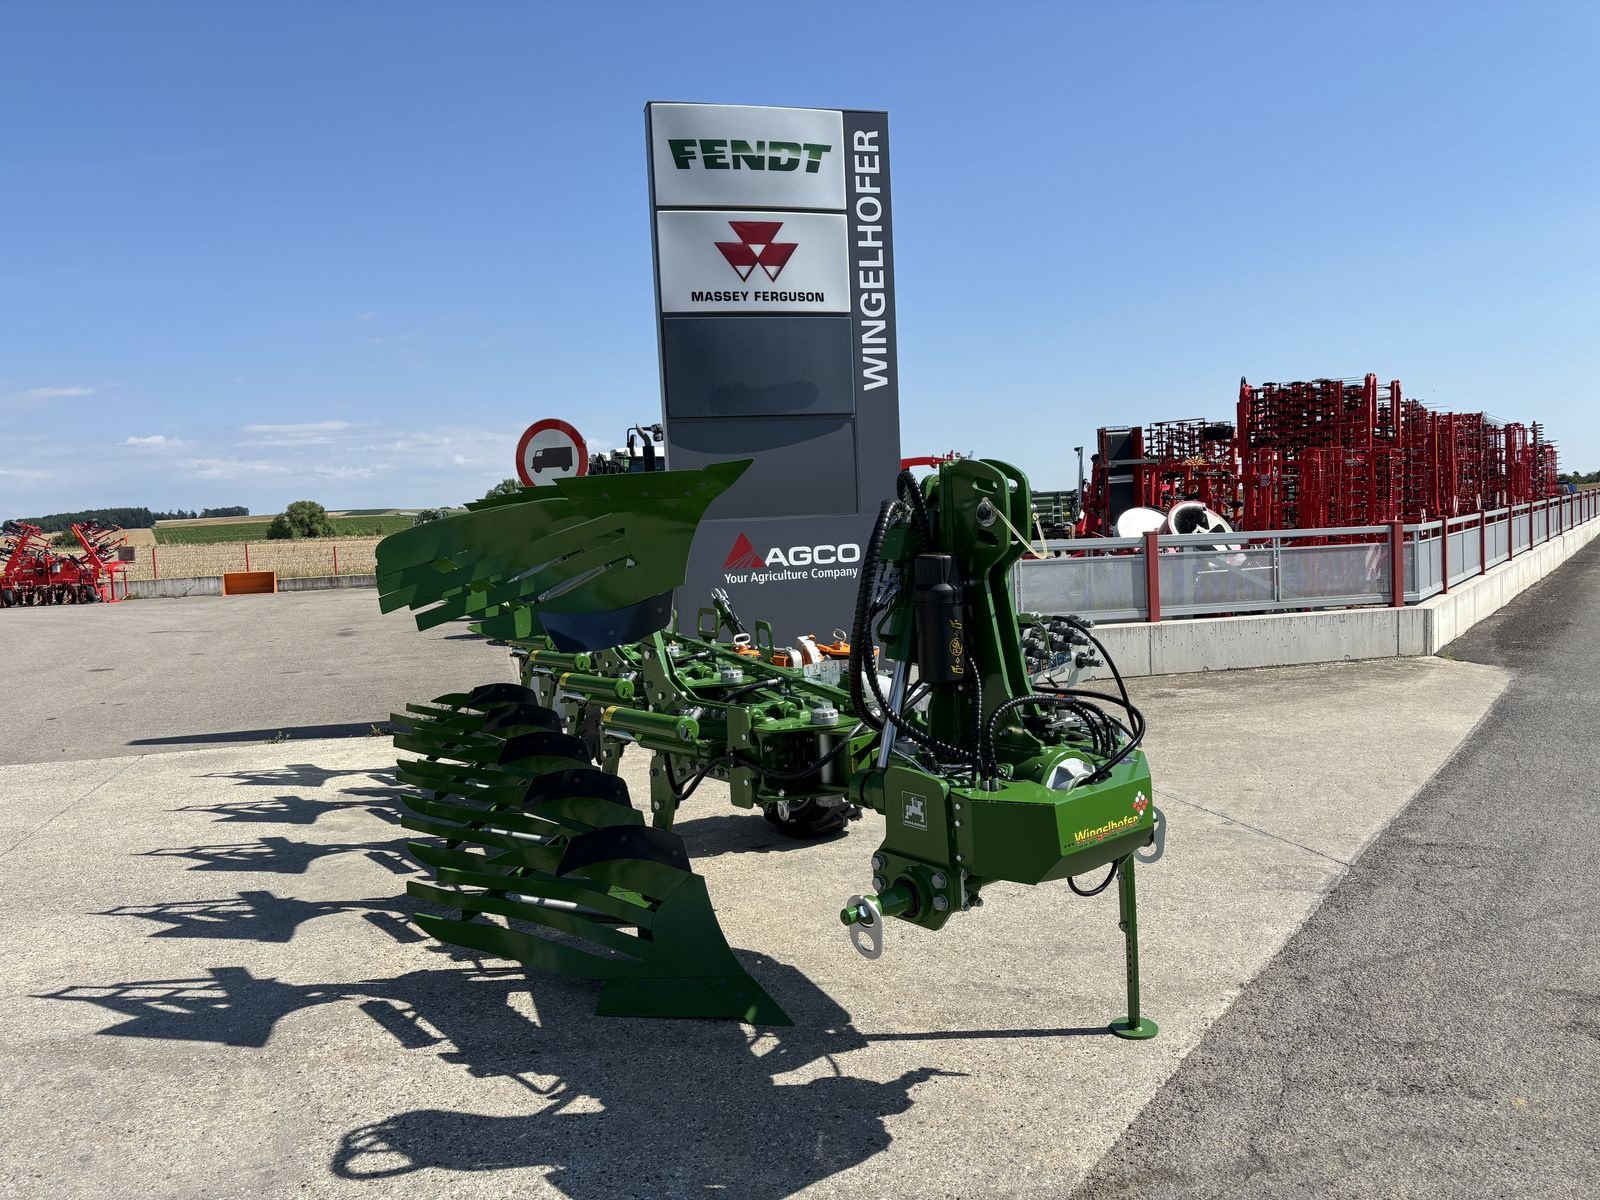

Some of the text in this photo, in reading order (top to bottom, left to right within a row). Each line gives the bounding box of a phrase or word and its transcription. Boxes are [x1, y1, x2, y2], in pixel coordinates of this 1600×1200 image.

[668, 139, 832, 174] FENDT
[853, 129, 888, 391] WINGELHOFER
[691, 291, 825, 303] MASSEY FERGUSON
[764, 543, 861, 568] AGCO
[724, 567, 859, 585] Your Agriculture Company
[1074, 815, 1139, 841] Wingelhofer
